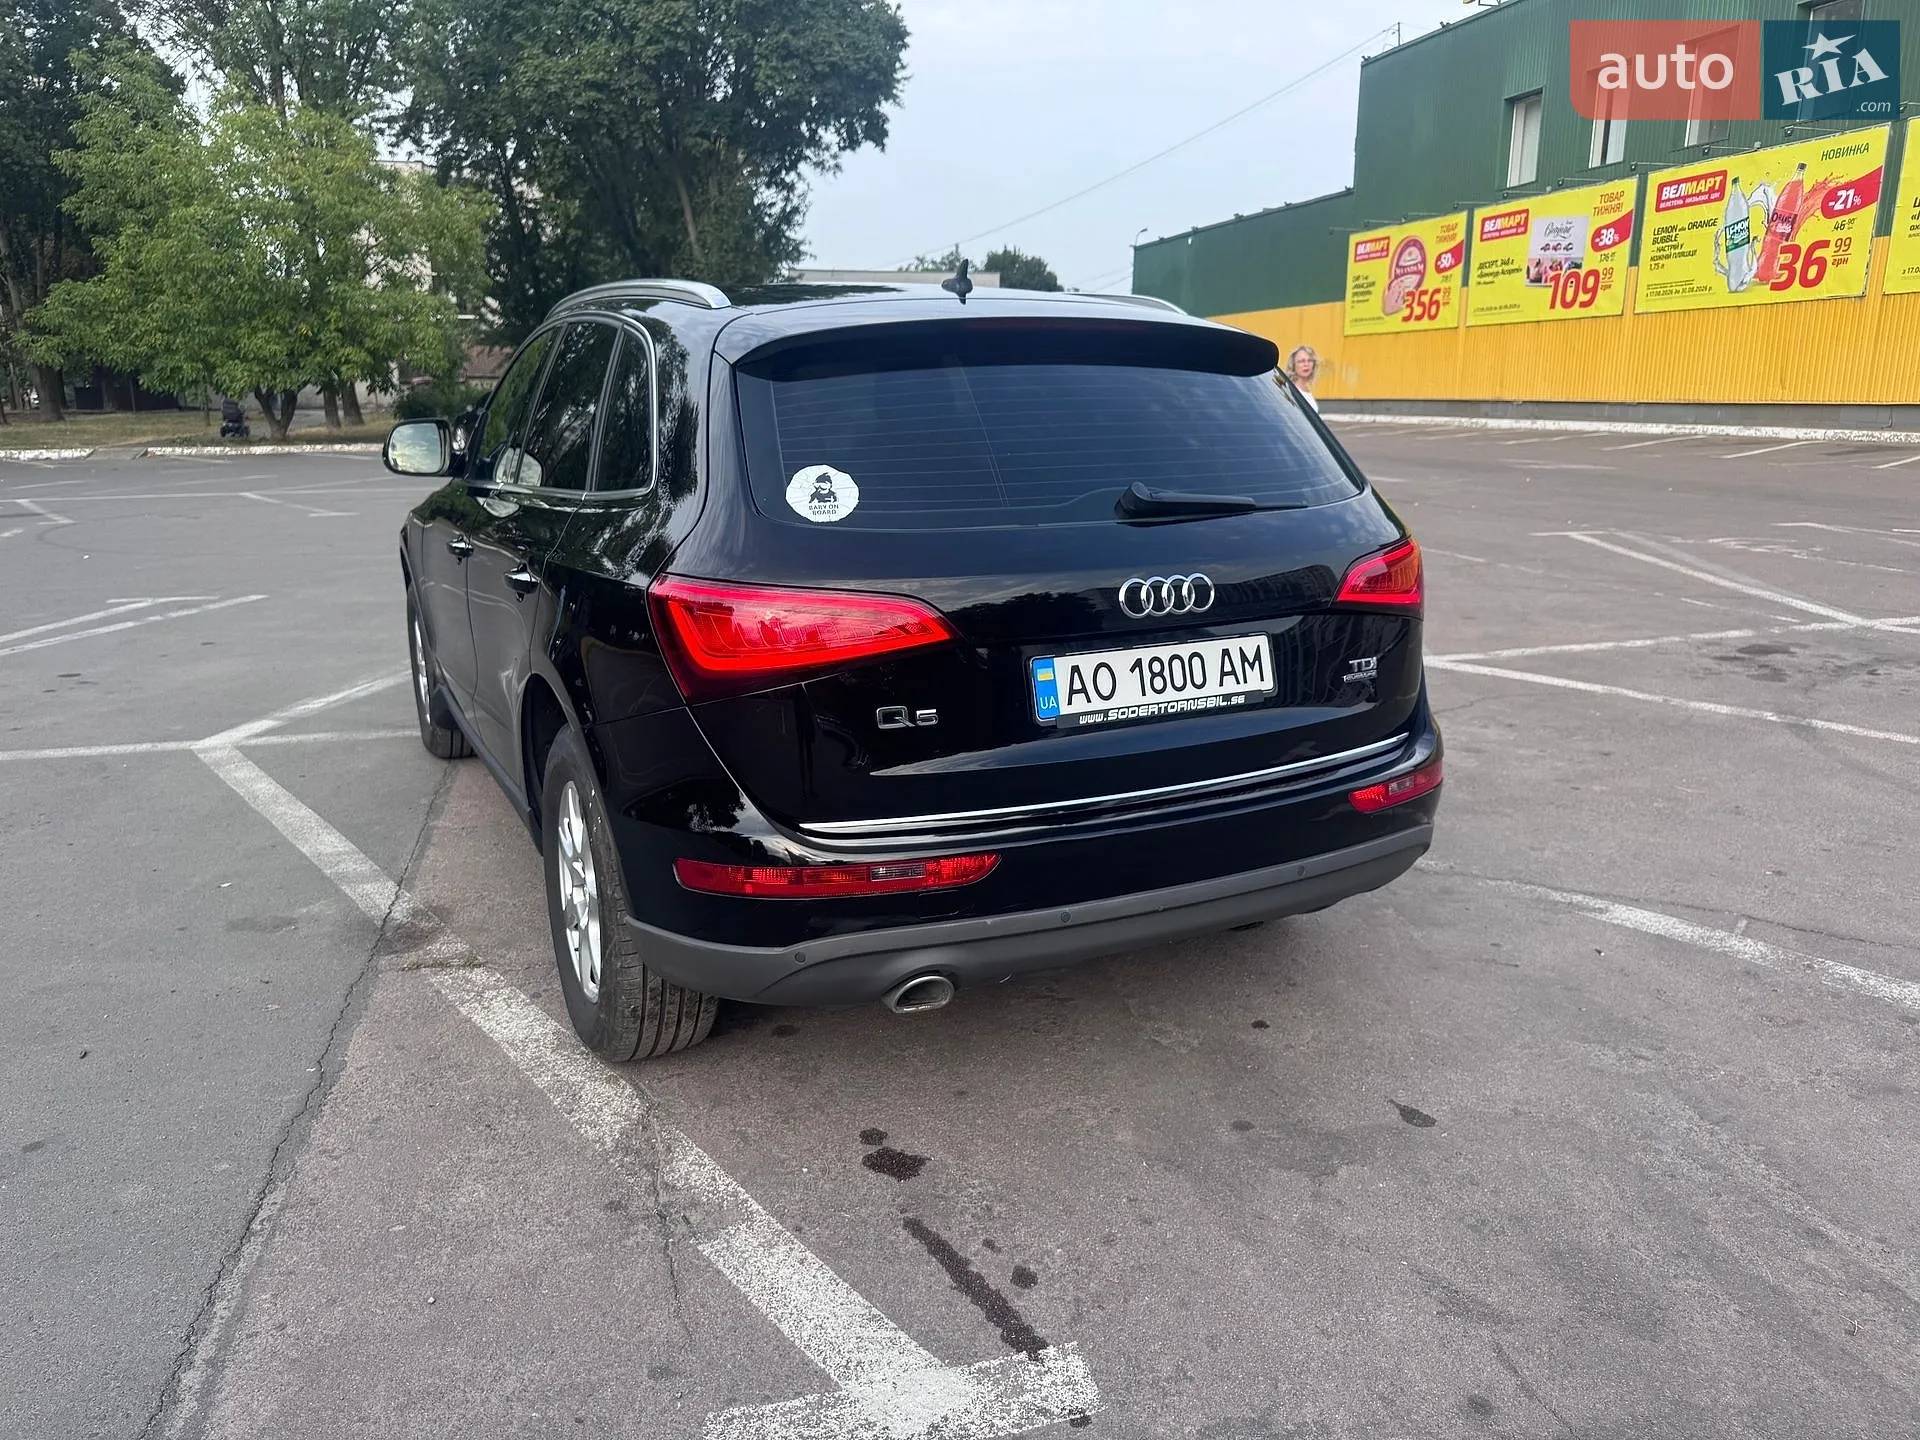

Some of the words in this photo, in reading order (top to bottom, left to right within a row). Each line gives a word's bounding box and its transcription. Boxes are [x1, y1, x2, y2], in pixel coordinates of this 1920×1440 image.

[1821, 142, 1870, 161] НОВИНКА
[1599, 190, 1624, 205] ТОВАР
[1660, 175, 1723, 201] ВЕЛМАРТ
[1828, 188, 1862, 211] -21%
[1593, 203, 1624, 217] ТИЖНЯ!
[1483, 212, 1527, 233] ВЕЛМАРТ
[1653, 224, 1678, 236] LEMON
[1687, 218, 1718, 231] ORANGE
[1726, 218, 1750, 238] LEMON
[1652, 233, 1679, 246] BUBBLE
[1834, 236, 1852, 253] 99
[1770, 240, 1830, 292] 36
[1831, 257, 1849, 267] грн
[1907, 265, 1920, 275] 17.0
[1602, 267, 1614, 280] 99
[1549, 269, 1600, 310] 109
[1401, 288, 1441, 323] 356
[1066, 661, 1117, 706] AO
[1129, 651, 1207, 697] 1800
[1218, 644, 1265, 687] AM
[1040, 697, 1057, 709] UA
[876, 705, 939, 729] Q5
